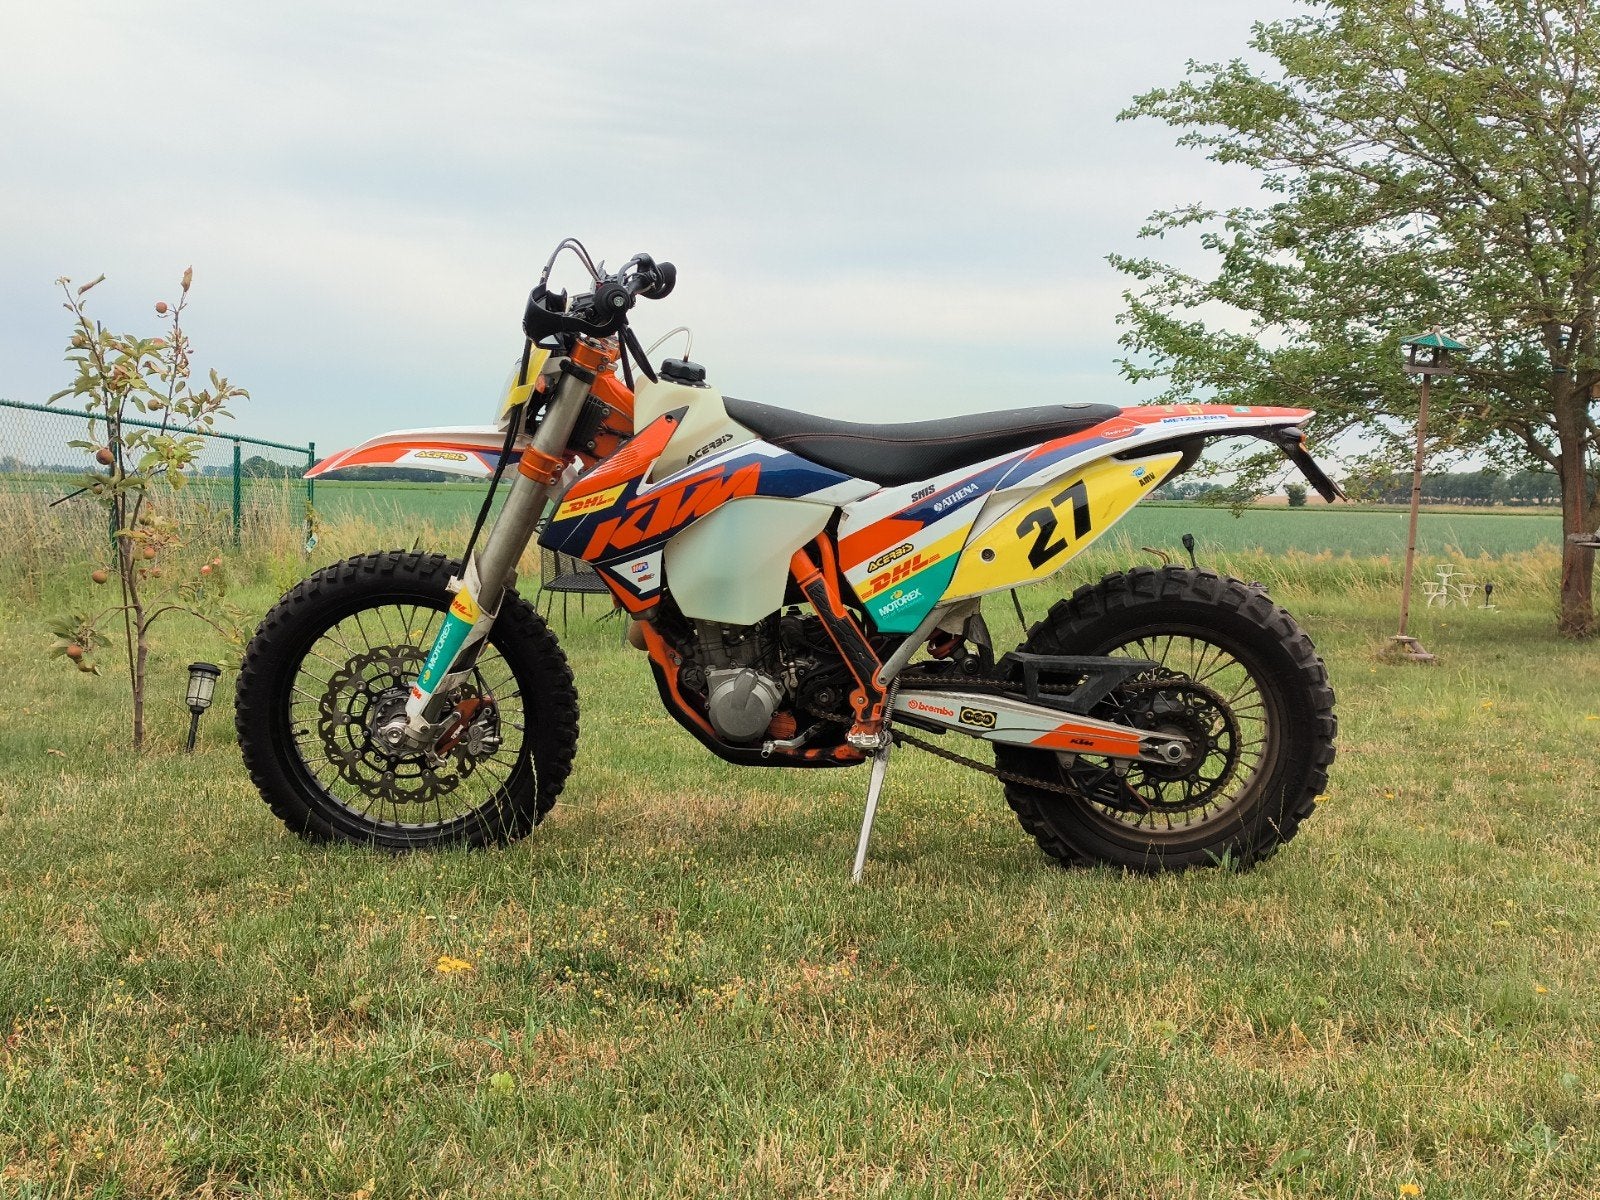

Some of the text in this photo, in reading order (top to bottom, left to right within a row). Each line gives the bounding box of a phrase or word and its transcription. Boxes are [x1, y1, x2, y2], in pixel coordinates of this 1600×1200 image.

[414, 450, 468, 462] ACERBIS
[687, 433, 734, 465] ACERBIS
[568, 494, 608, 511] DHL
[580, 461, 762, 561] KTM
[941, 483, 980, 512] ATHENA
[1015, 478, 1092, 571] 27
[867, 543, 914, 573] ACERBIS
[869, 554, 930, 595] DHL
[878, 588, 922, 617] MOTOREX
[427, 621, 453, 670] MOTOREX
[918, 702, 954, 716] brembo
[1070, 738, 1095, 746] KTM
